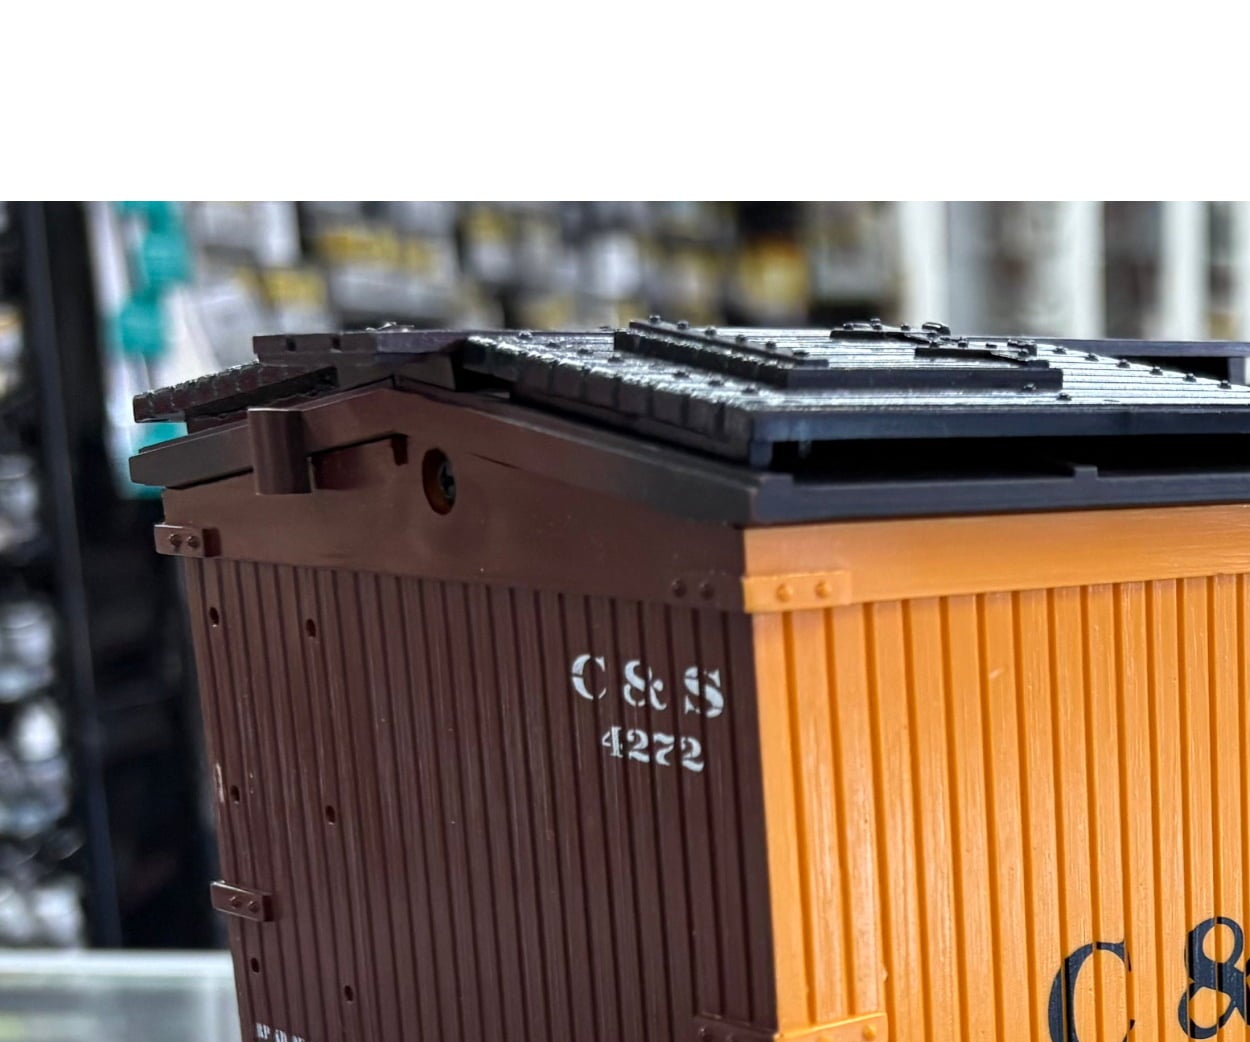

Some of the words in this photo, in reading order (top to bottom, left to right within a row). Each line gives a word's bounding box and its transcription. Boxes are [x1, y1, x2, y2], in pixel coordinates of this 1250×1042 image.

[571, 654, 607, 700] C
[623, 660, 667, 710] &
[684, 666, 724, 718] S
[602, 726, 704, 772] 4272
